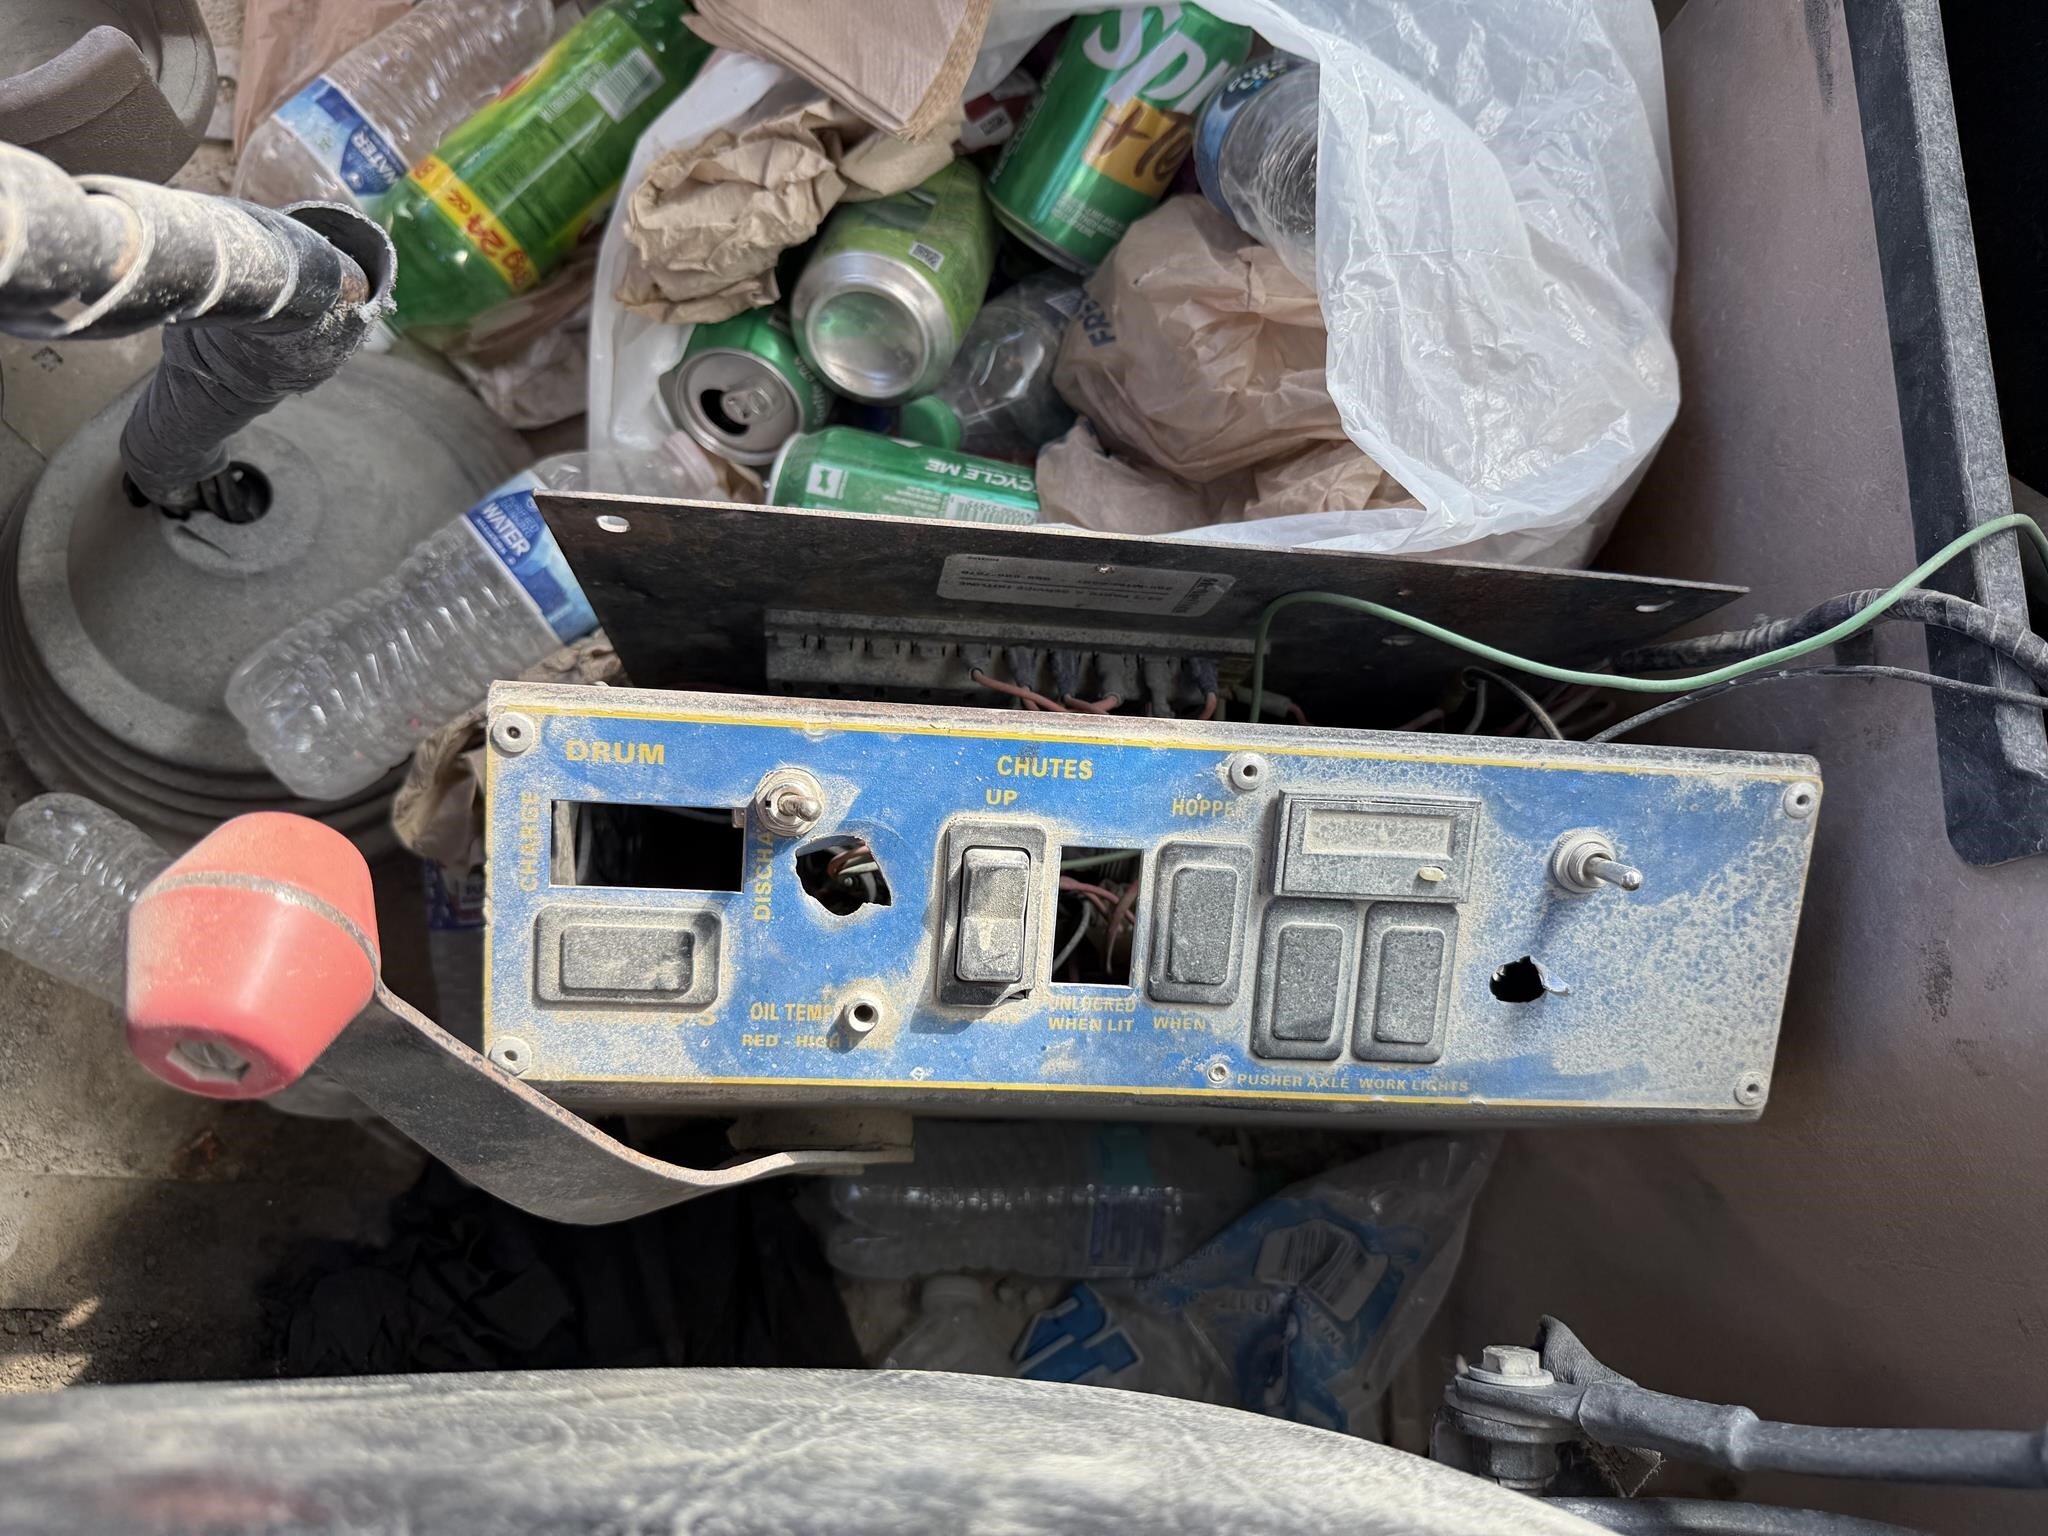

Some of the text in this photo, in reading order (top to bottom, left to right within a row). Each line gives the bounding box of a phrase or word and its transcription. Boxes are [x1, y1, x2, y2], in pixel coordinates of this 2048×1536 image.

[351, 130, 399, 185] WATER
[446, 189, 472, 214] oz
[467, 213, 507, 258] 24
[924, 458, 1037, 492] CYCLE ME
[481, 501, 531, 557] WATER
[565, 738, 665, 765] DRUM
[996, 755, 1094, 781] CHUTES
[985, 788, 1018, 807] UP
[518, 791, 540, 892] CHARGE
[753, 830, 775, 922] DISCHA
[749, 1003, 835, 1022] OIL TEMP
[1048, 995, 1137, 1013] UNLOCKED
[1048, 1017, 1134, 1033] WHEN LIT
[1152, 1016, 1206, 1031] WHEN
[741, 1034, 779, 1047] RED
[796, 1035, 840, 1049] HIGH
[1237, 1073, 1350, 1089] PUSHER AXLE
[1360, 1078, 1470, 1093] WORK LIGHTS
